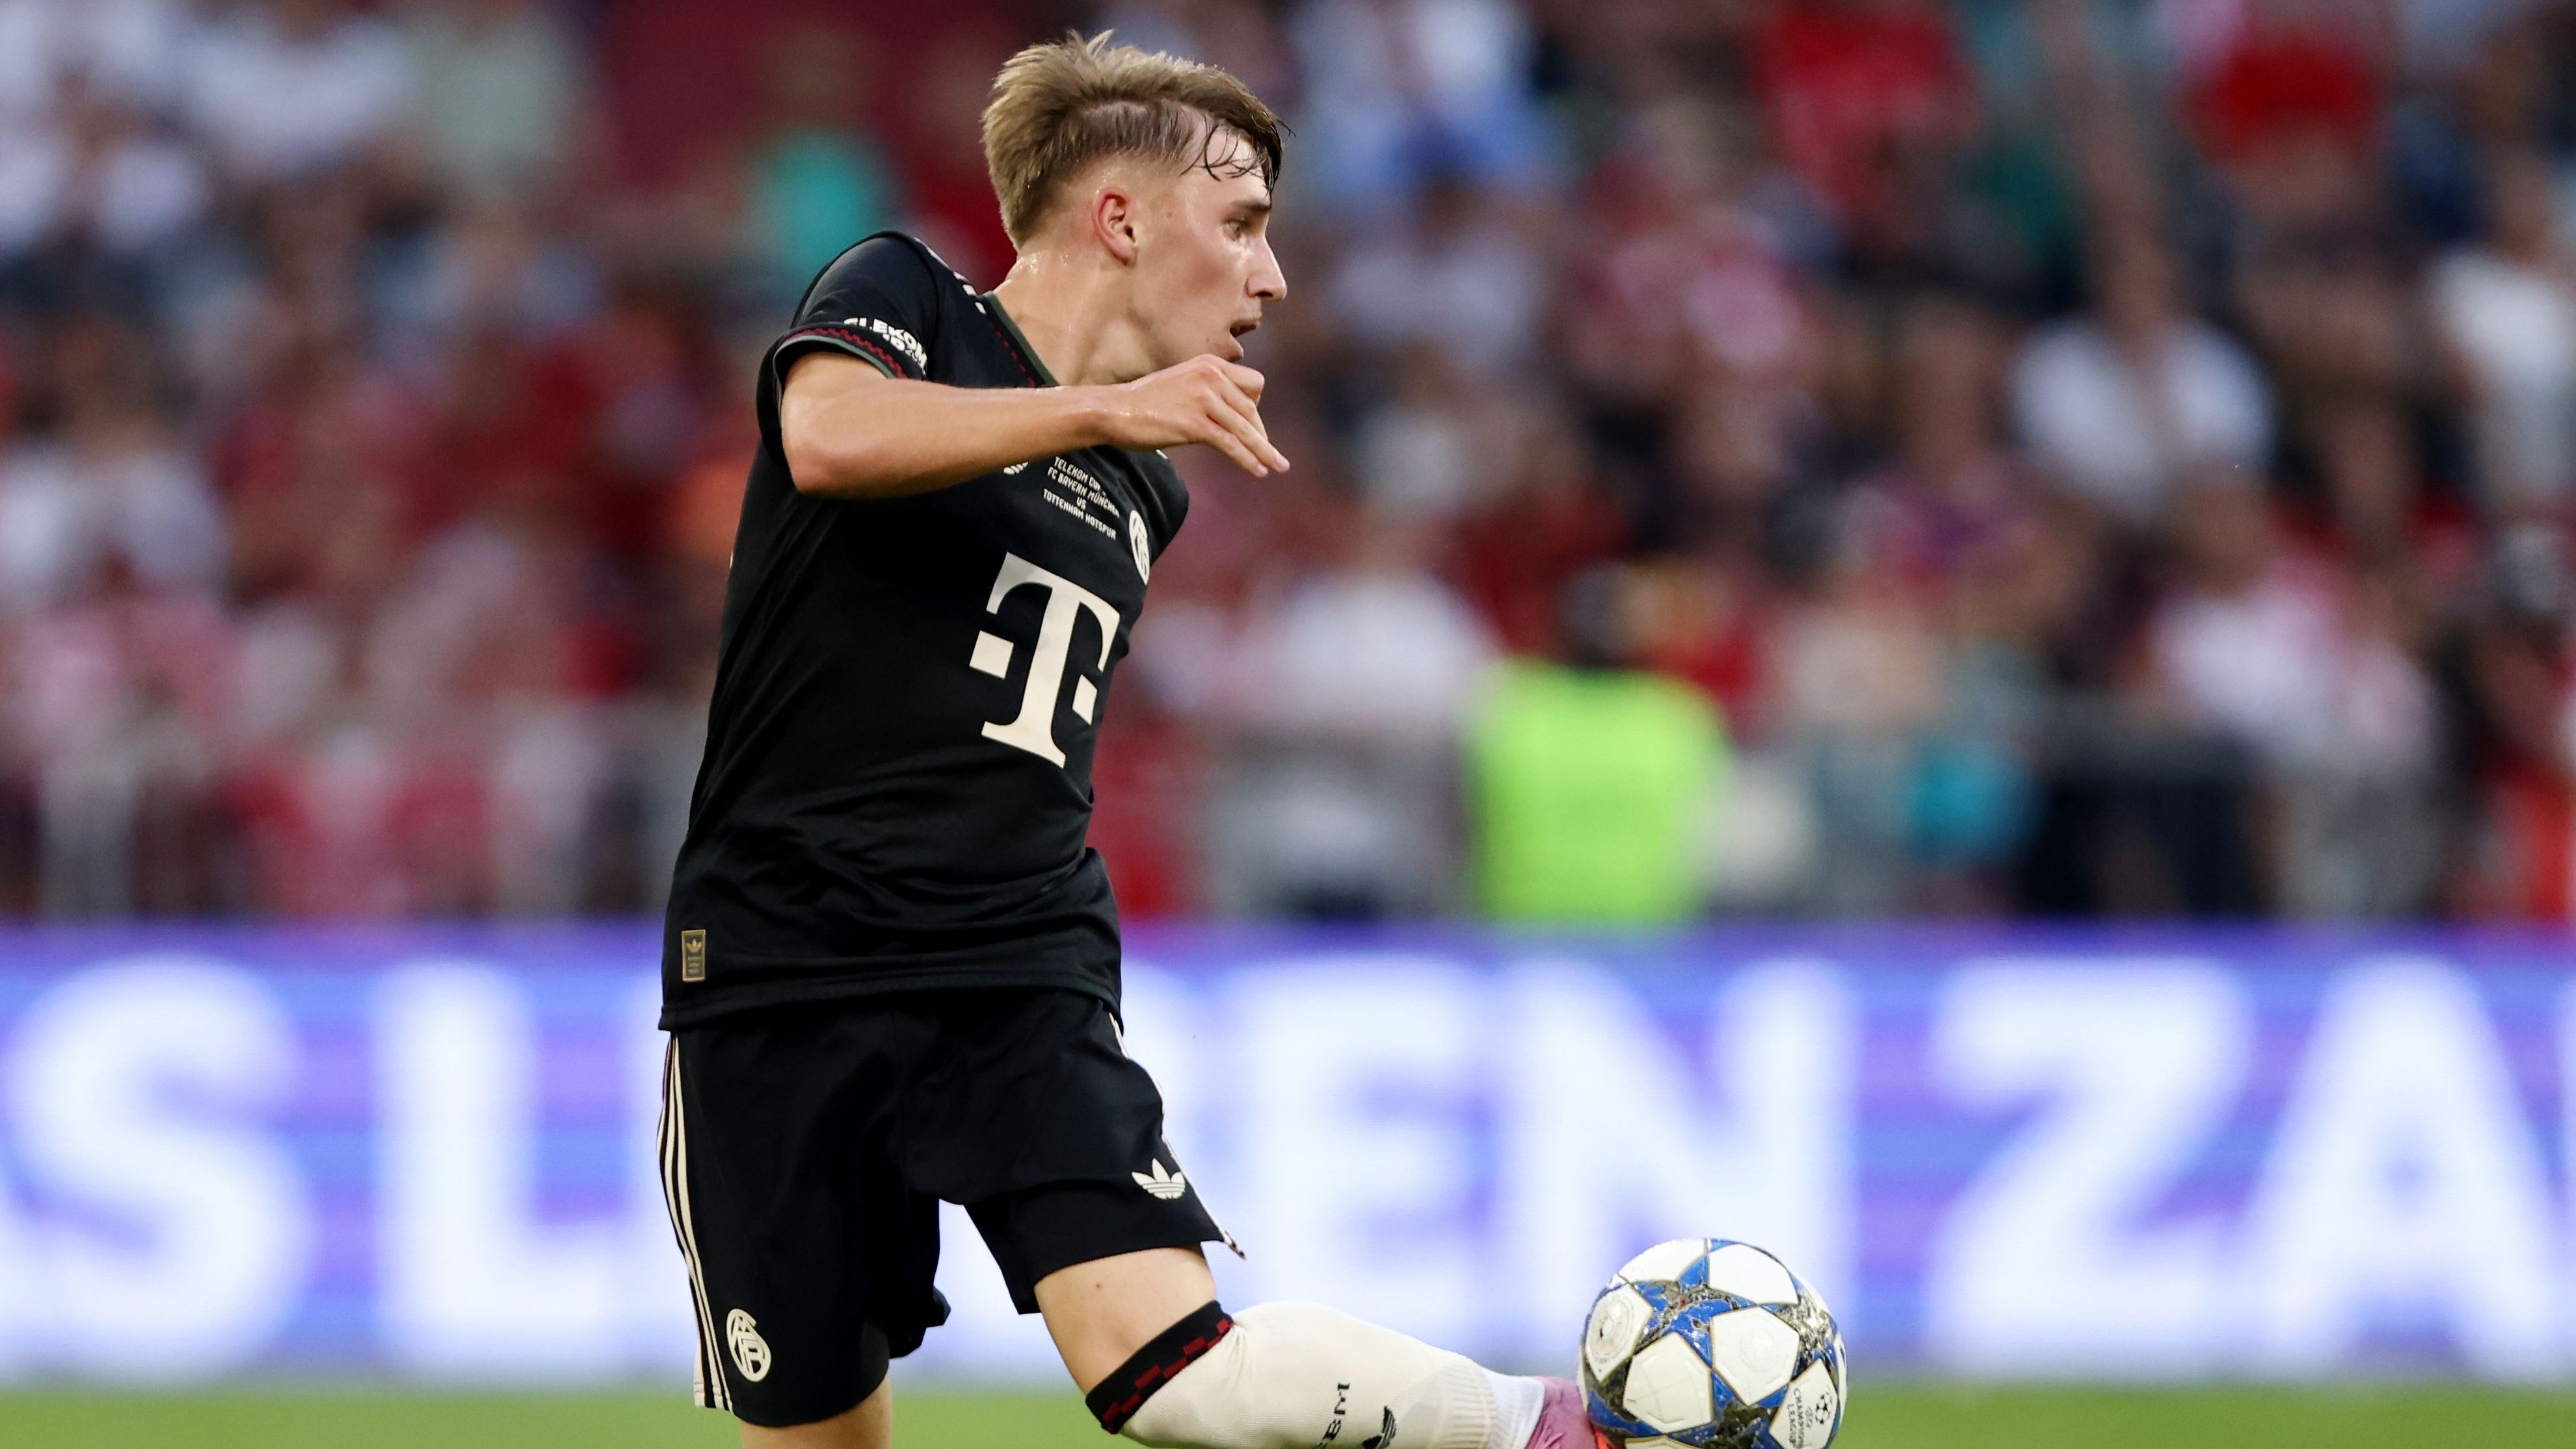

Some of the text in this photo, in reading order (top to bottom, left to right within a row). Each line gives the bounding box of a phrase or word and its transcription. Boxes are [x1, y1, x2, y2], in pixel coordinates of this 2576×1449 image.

[1048, 466, 1058, 480] FC
[1057, 473, 1088, 496] BAYERN
[1054, 456, 1089, 483] TELEKOM
[1043, 488, 1117, 540] TOTTENHAM HOTSPUR
[970, 552, 1120, 769] T
[0, 956, 2576, 1369] S LEN ZA
